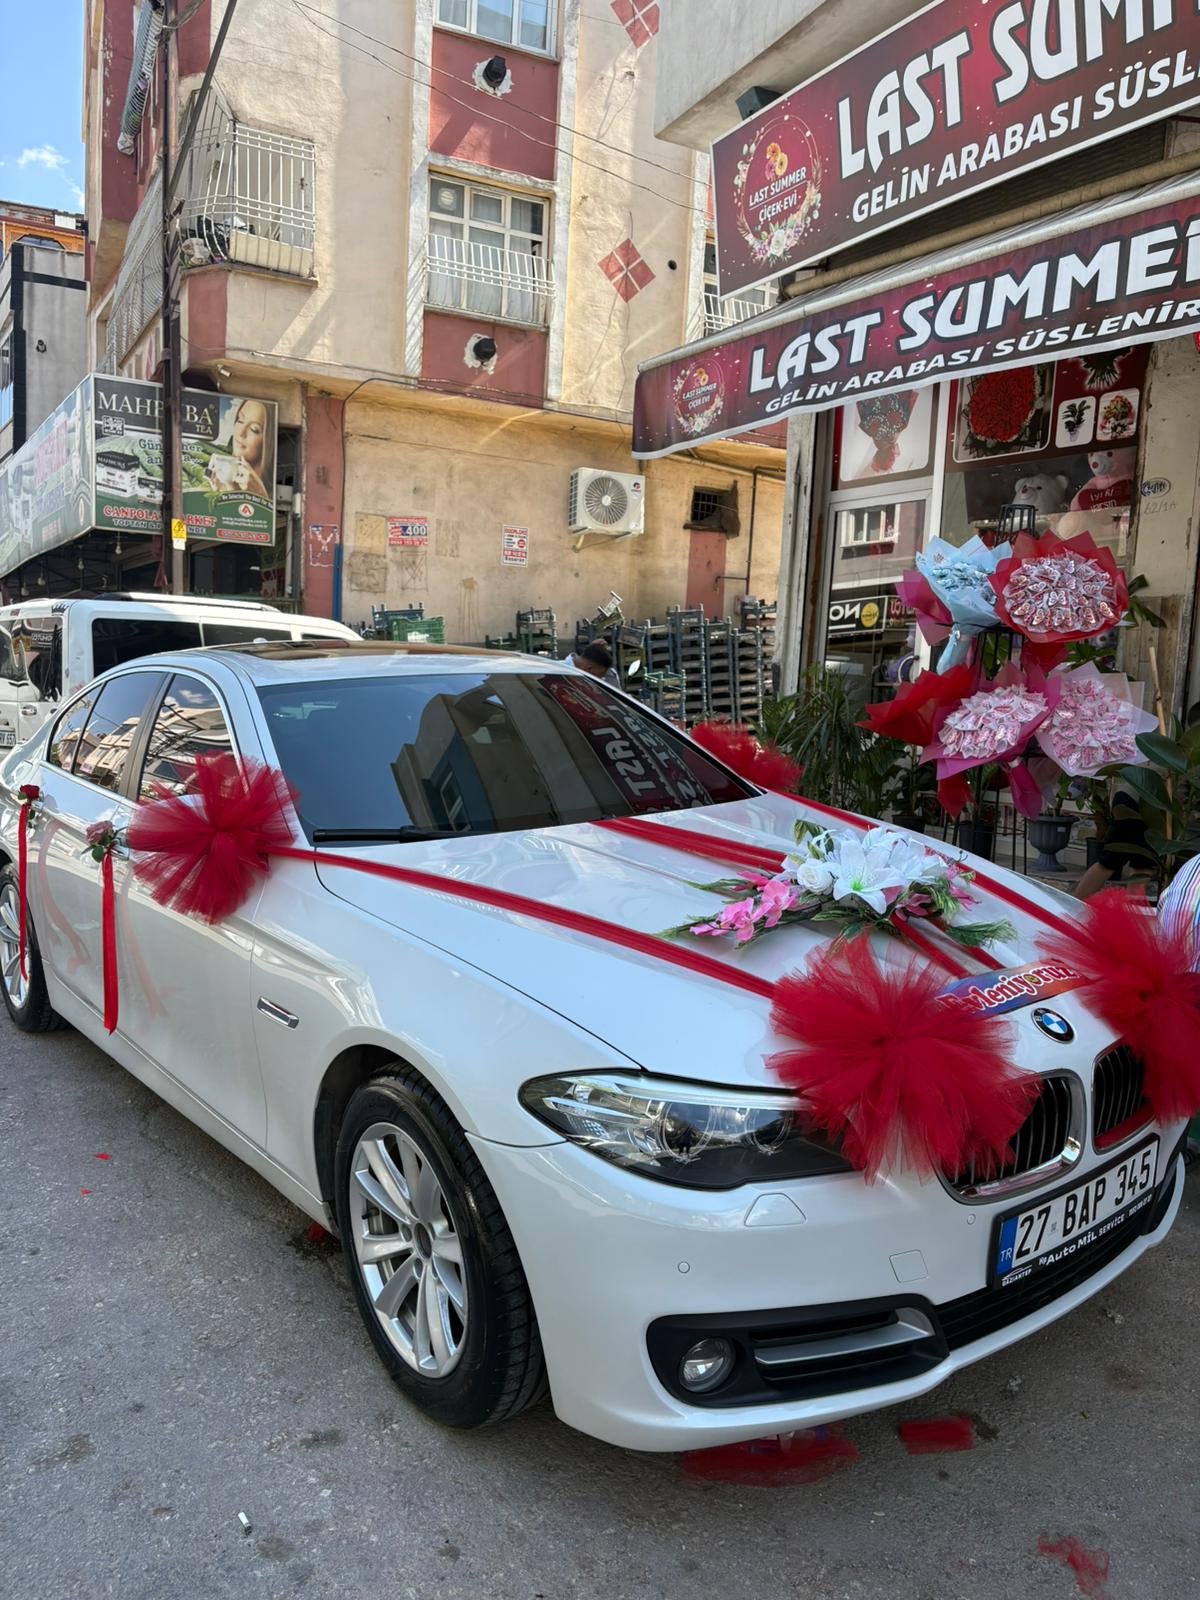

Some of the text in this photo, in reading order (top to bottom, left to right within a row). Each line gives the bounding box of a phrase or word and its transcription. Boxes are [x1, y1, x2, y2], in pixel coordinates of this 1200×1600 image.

[837, 0, 1200, 180] LAST SUM
[852, 50, 1200, 223] GELİN ARABASI SÜSL
[749, 166, 807, 207] LAST SUMMER
[748, 312, 881, 395] LAST
[764, 381, 838, 415] GELİN
[843, 345, 985, 393] ARABASI
[195, 423, 213, 435] TEA
[103, 504, 162, 522] CANPOLA
[405, 526, 427, 536] 400
[1014, 1205, 1052, 1261] 27
[1062, 1177, 1107, 1239] BAP
[1114, 1149, 1151, 1207] 345
[1000, 1247, 1013, 1263] TR
[1046, 1213, 1126, 1266] Auto MİL SERVİCE
